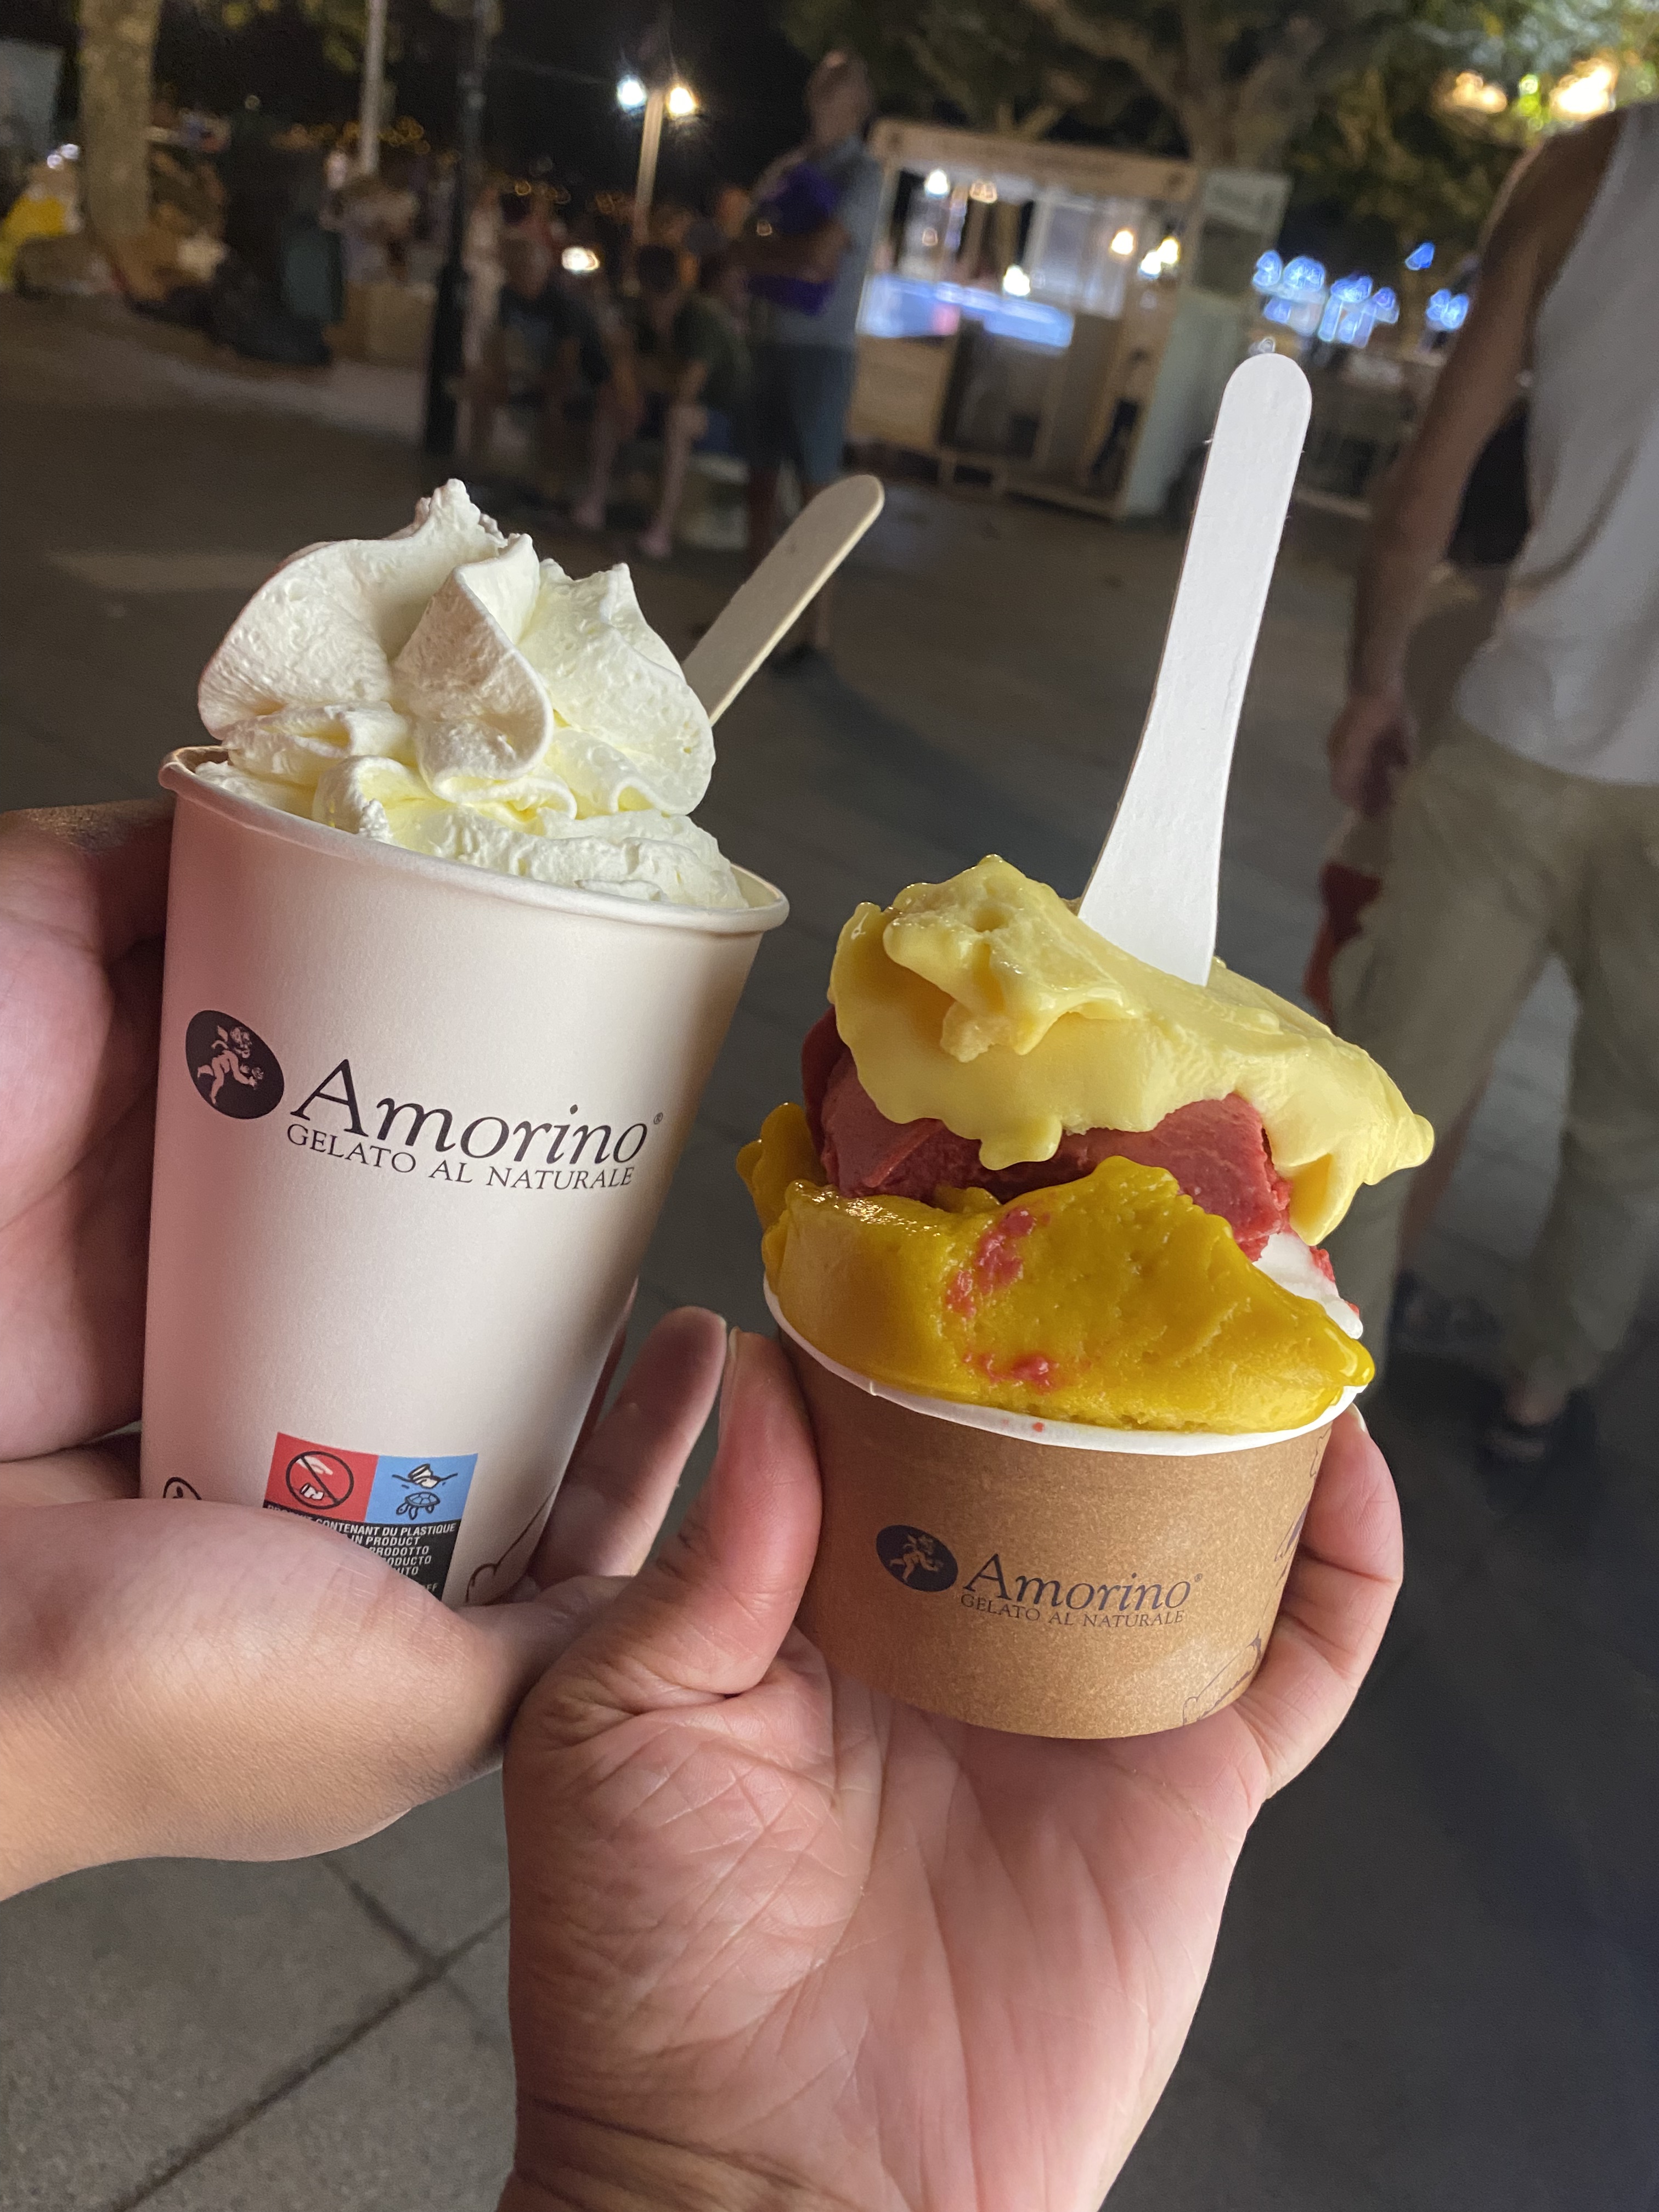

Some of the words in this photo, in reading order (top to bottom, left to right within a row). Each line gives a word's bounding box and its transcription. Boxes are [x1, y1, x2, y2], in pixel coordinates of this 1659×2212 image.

[287, 1123, 416, 1173] GELATO
[428, 1159, 473, 1184] AL
[486, 1166, 635, 1190] NATURALE
[382, 1526, 398, 1536] DU
[400, 1522, 457, 1536] PLASTIQUE
[365, 1537, 421, 1547] PRODUCT
[960, 1593, 1041, 1621] GELATO
[1048, 1612, 1074, 1626] AL
[1083, 1610, 1184, 1628] NATURALE
